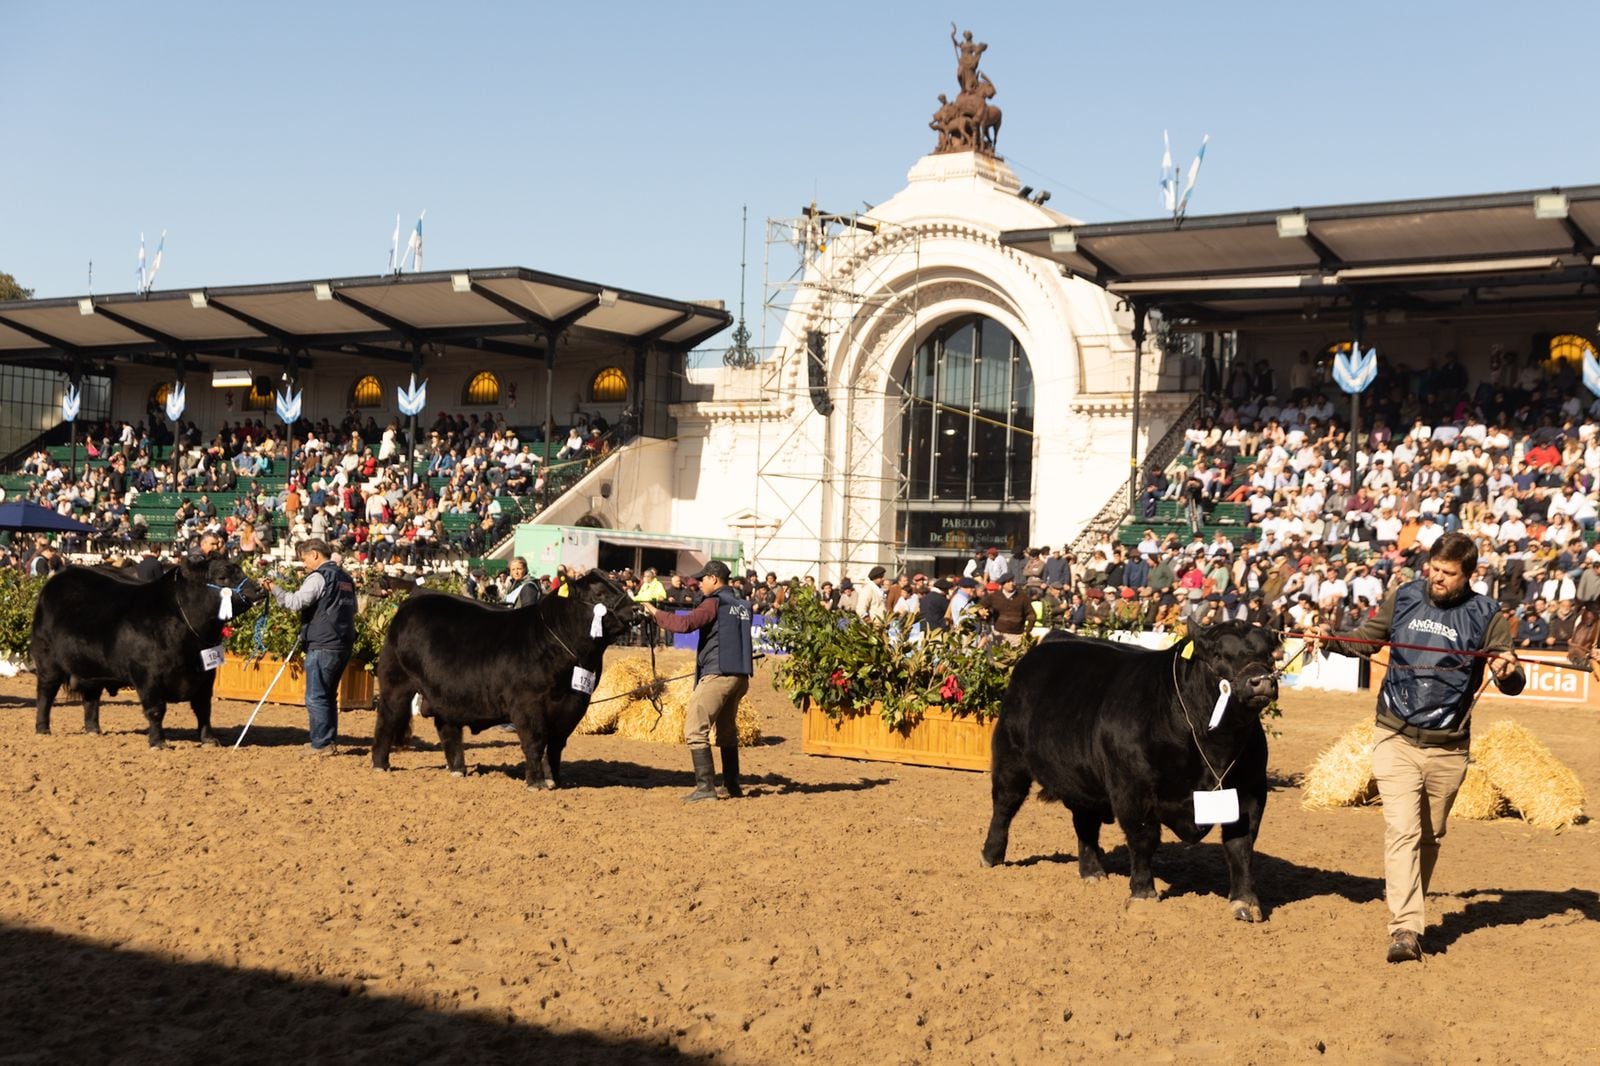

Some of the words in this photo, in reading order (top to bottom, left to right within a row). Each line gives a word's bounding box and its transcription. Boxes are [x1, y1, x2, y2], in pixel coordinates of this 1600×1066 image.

[942, 518, 997, 529] PABELLON
[930, 532, 943, 542] Dr.
[1487, 663, 1578, 693] licia
